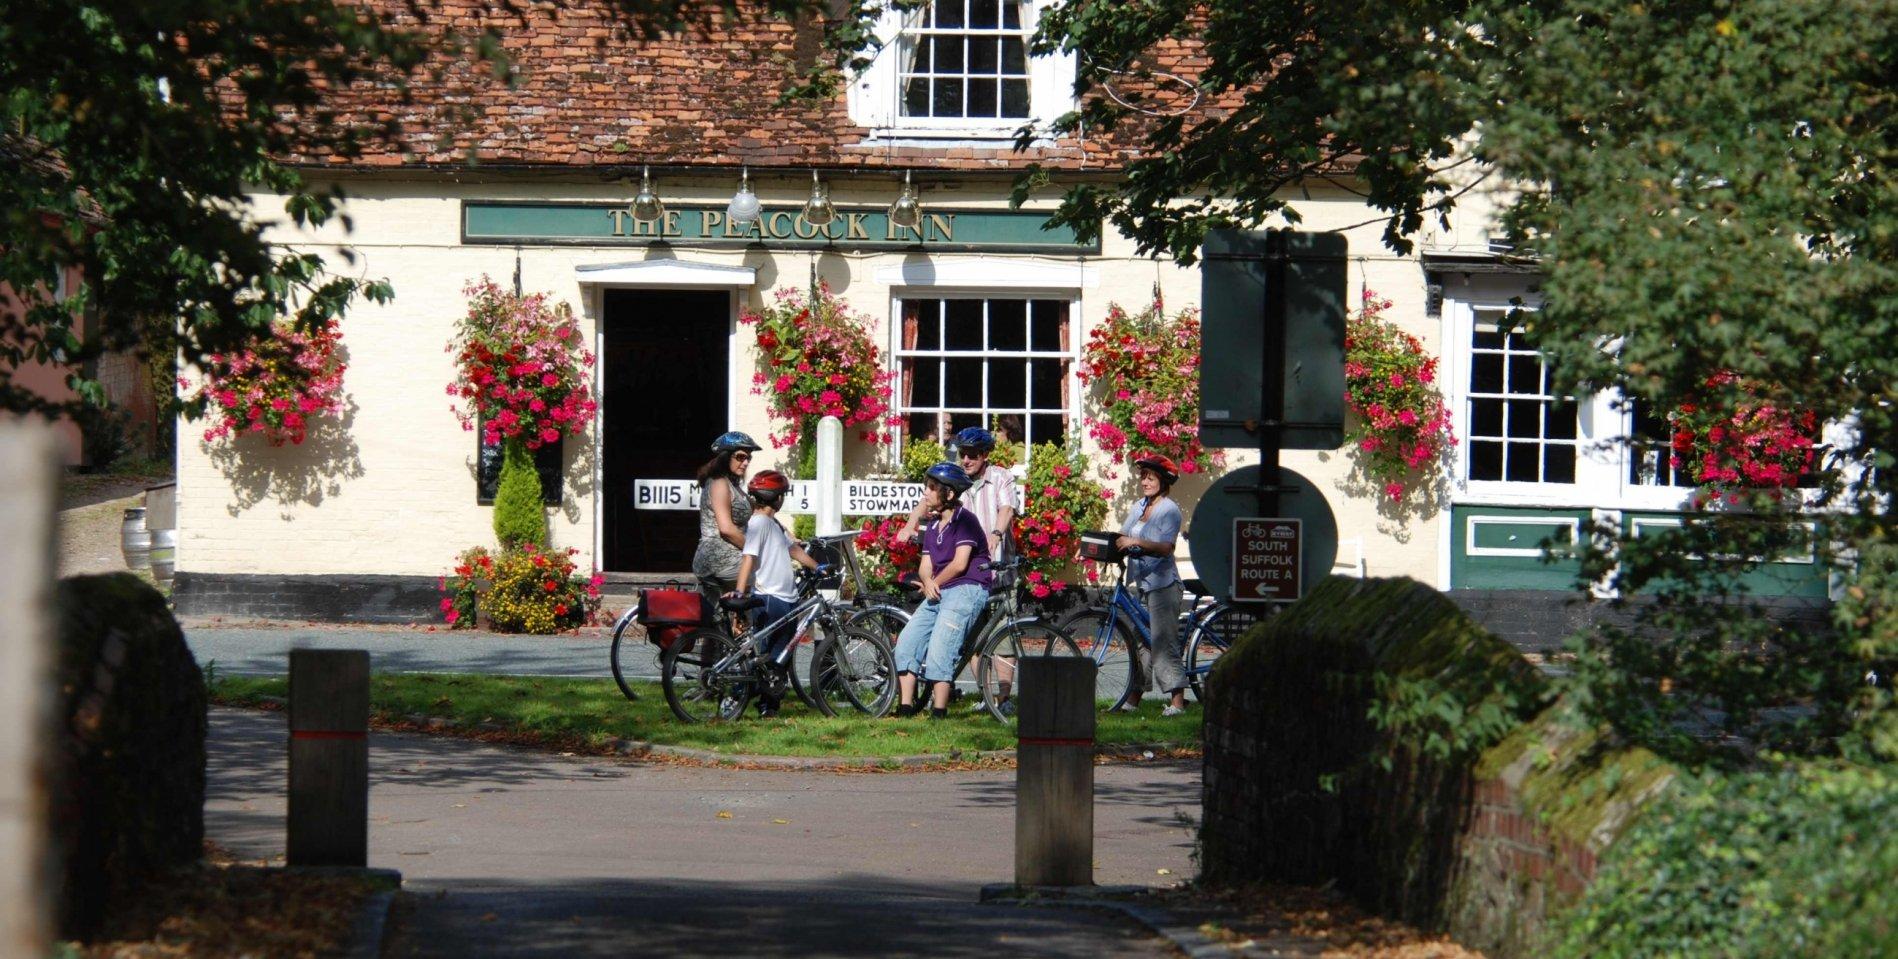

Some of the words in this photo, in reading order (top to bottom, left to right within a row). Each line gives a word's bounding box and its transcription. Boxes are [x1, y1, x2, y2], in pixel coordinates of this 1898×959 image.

[607, 210, 683, 236] THE
[700, 211, 870, 240] PEACOCK
[885, 213, 955, 241] INN
[639, 486, 681, 504] B1115
[801, 499, 809, 510] 5
[849, 499, 920, 511] STOWMAR
[1248, 540, 1288, 551] SOUTH
[1241, 554, 1293, 565] SUFFOLK
[1241, 568, 1280, 579] ROUTE
[1284, 569, 1292, 580] A
